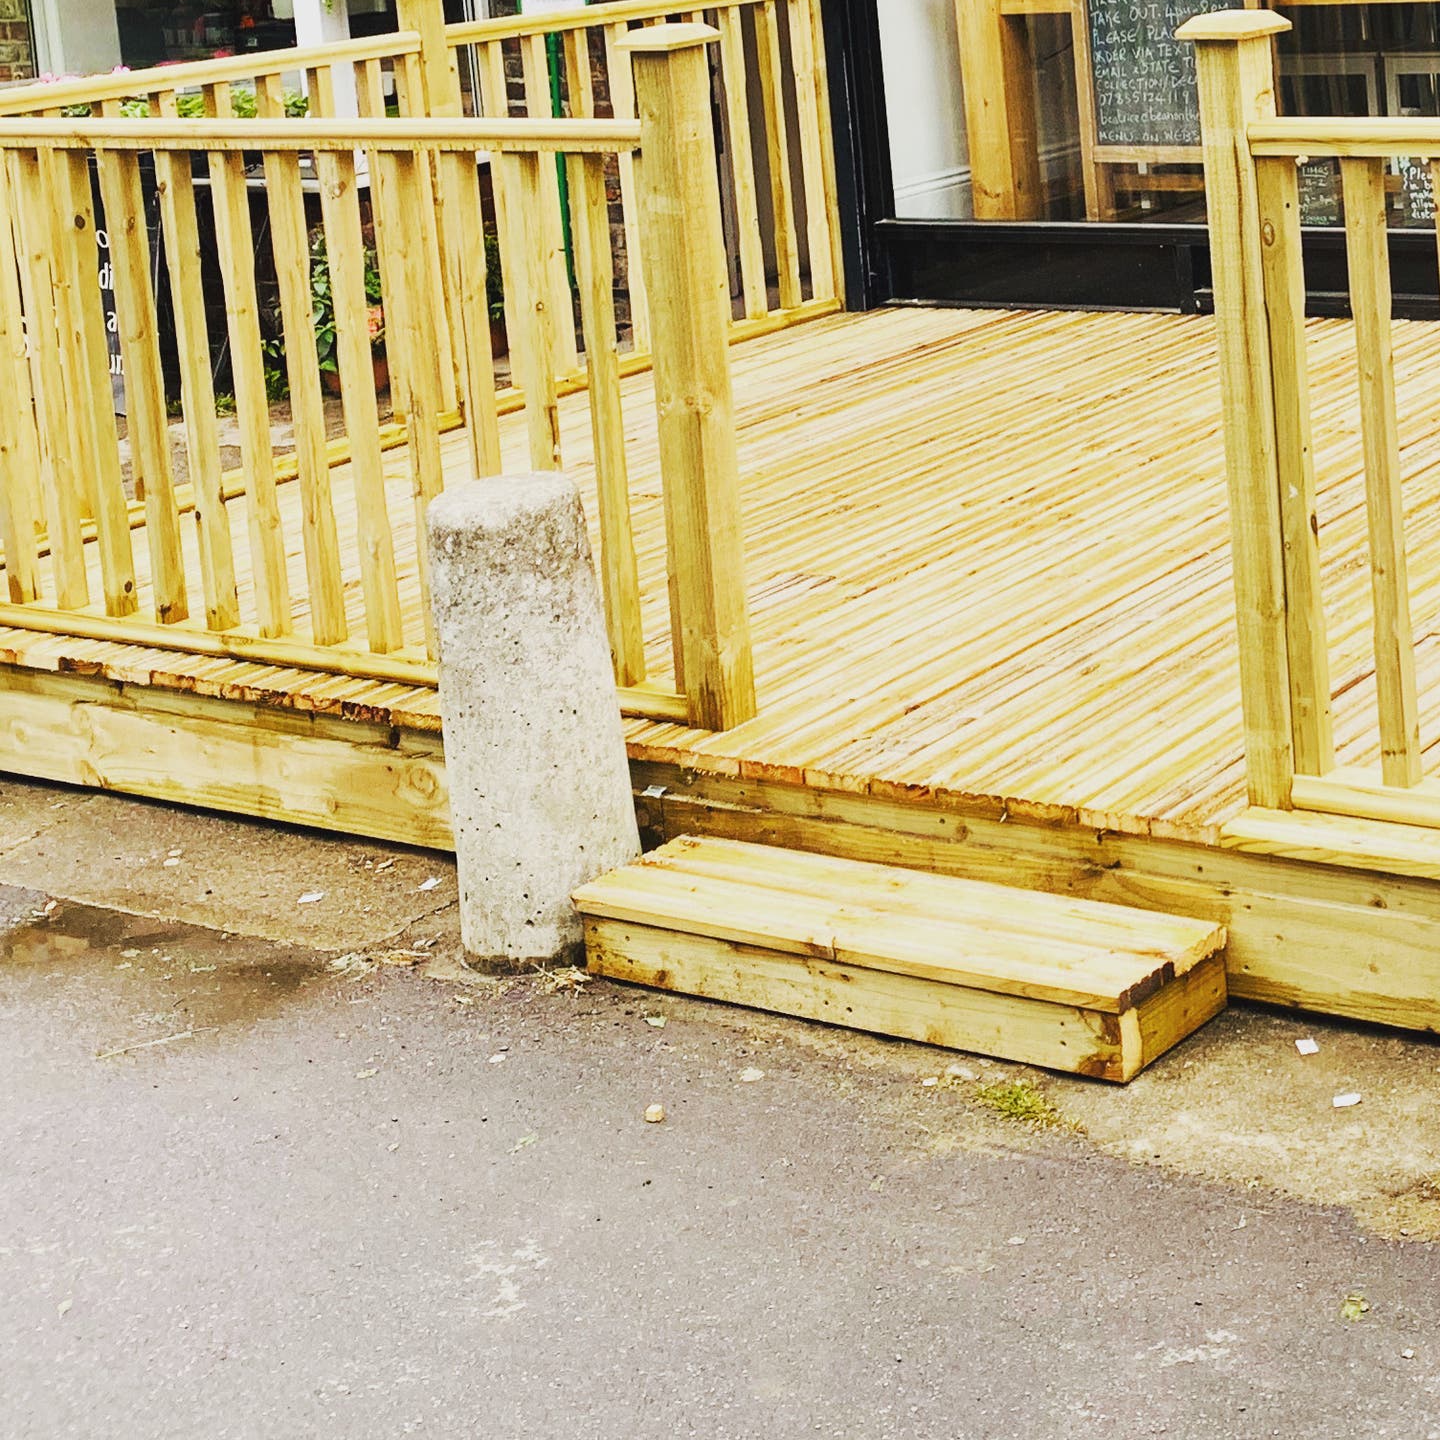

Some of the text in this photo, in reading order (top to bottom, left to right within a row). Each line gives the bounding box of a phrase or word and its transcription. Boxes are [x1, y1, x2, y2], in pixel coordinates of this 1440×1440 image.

[1090, 10, 1121, 29] TAKE
[1092, 25, 1176, 47] PLEASE PLAC
[1132, 47, 1154, 60] VIA
[1157, 43, 1192, 57] TEXT
[1095, 65, 1127, 80] EMAIL
[1099, 130, 1134, 142] MENU
